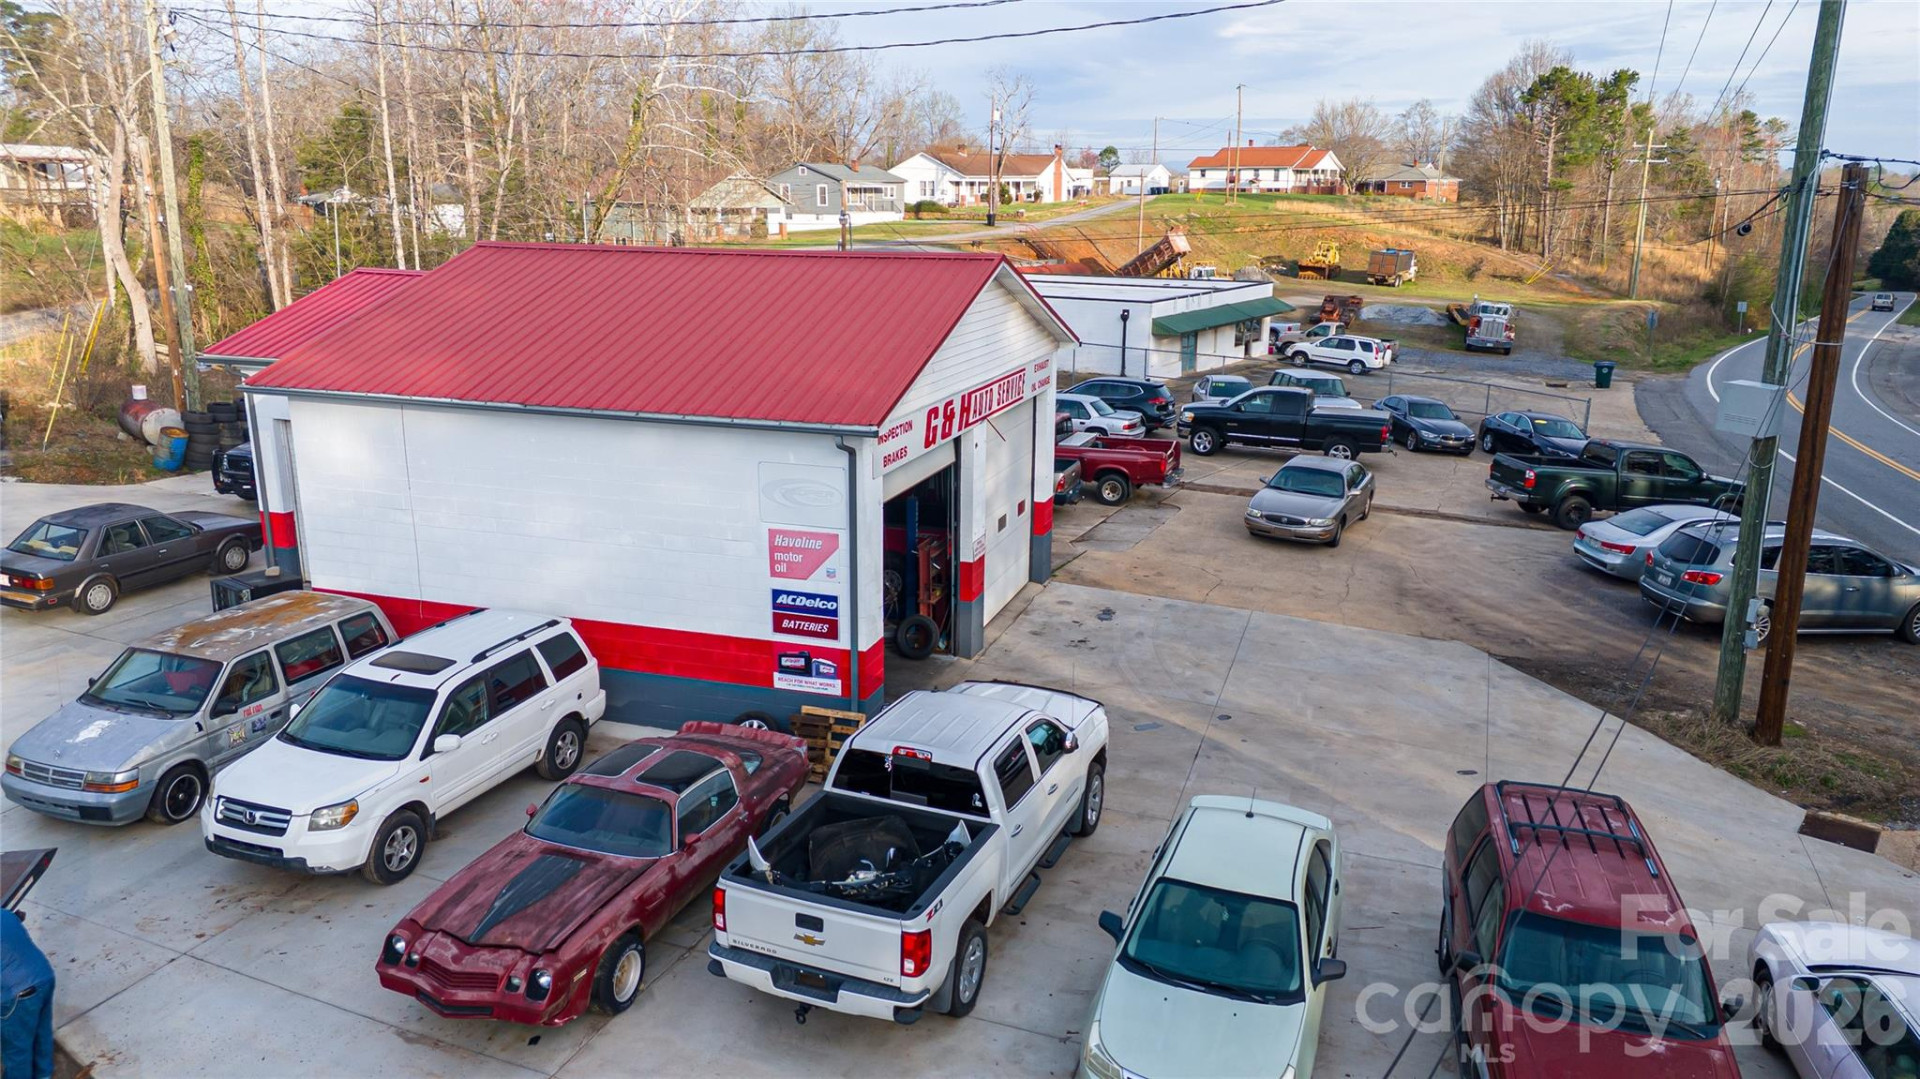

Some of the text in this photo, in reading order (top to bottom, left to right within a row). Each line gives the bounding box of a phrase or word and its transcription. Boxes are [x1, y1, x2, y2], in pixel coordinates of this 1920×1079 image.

[972, 388, 993, 419] AUTO
[996, 372, 1026, 407] SERVICE
[877, 420, 913, 446] INSPECTION
[883, 446, 908, 468] BRAKES
[774, 534, 822, 550] Havoline
[774, 551, 803, 563] motor
[774, 563, 787, 573] oil
[776, 594, 837, 610] ACDelco
[782, 619, 829, 633] BATTERIES
[732, 939, 777, 954] SILVERADO
